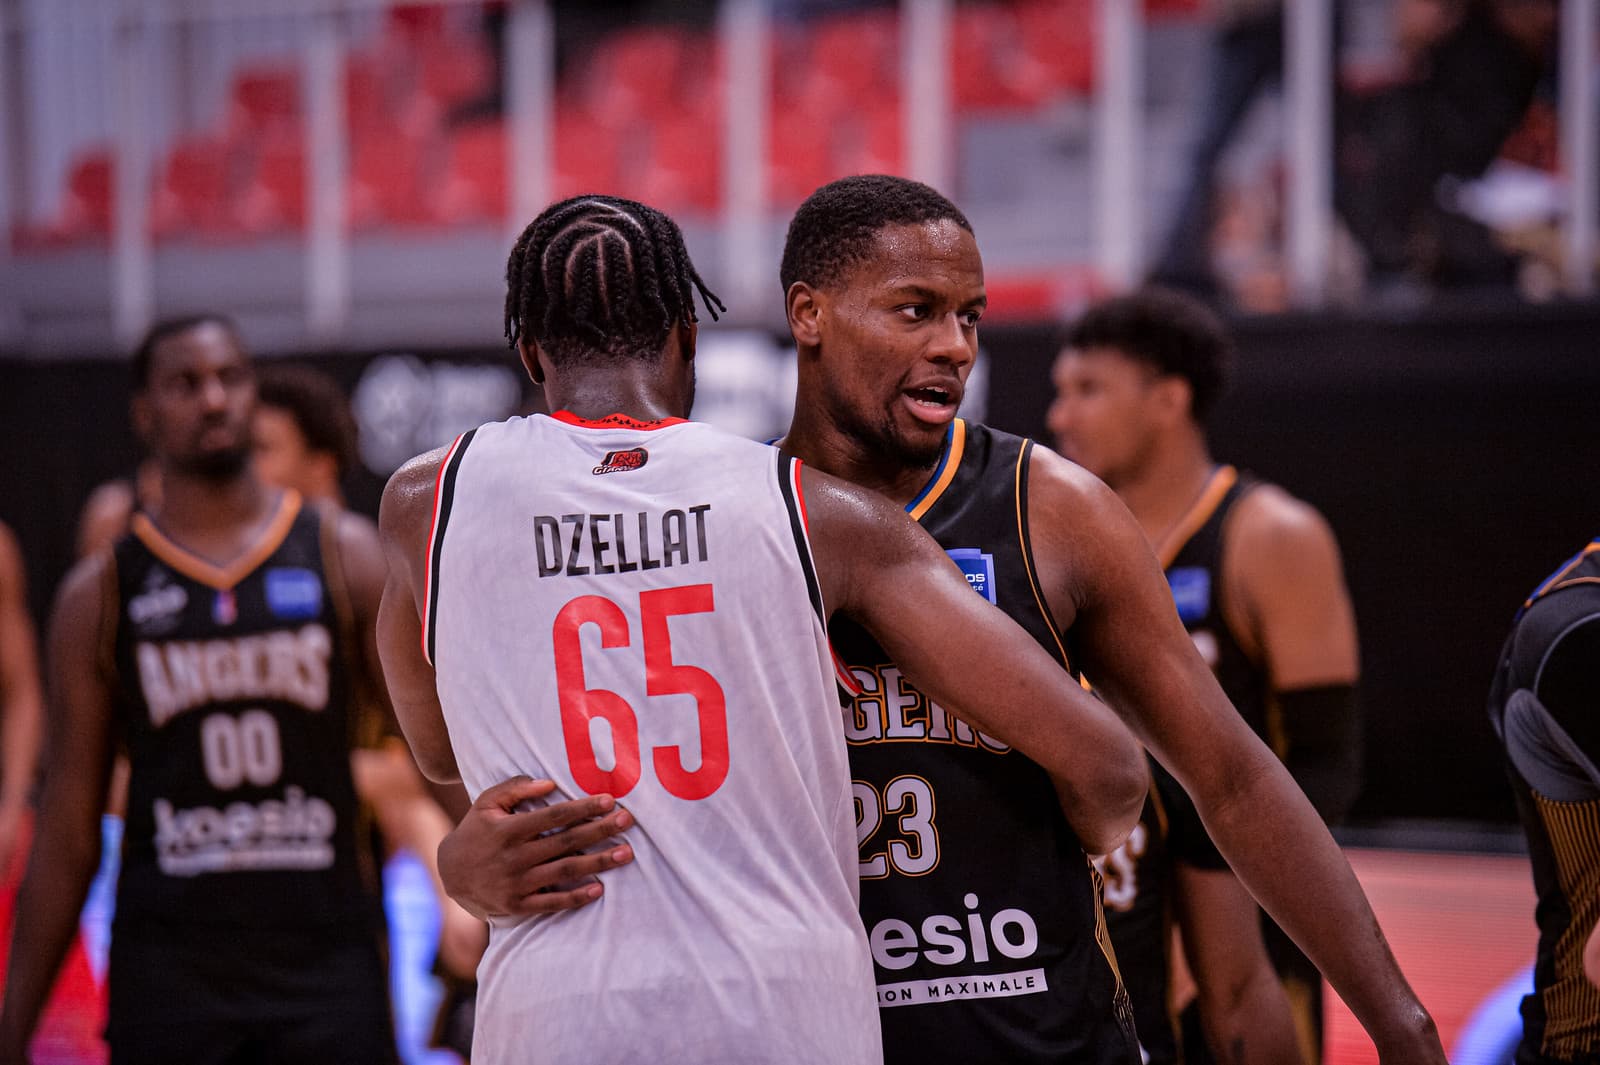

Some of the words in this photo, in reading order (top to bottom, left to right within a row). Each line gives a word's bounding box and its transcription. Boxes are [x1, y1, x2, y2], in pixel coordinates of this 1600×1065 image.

[534, 504, 711, 578] DZELLAT
[136, 623, 333, 727] ANGERS
[552, 583, 730, 801] 65
[845, 664, 1012, 755] GE
[201, 709, 283, 790] 00
[851, 774, 941, 880] 23
[869, 892, 1039, 970] esio
[927, 976, 1036, 998] MAXIMALE
